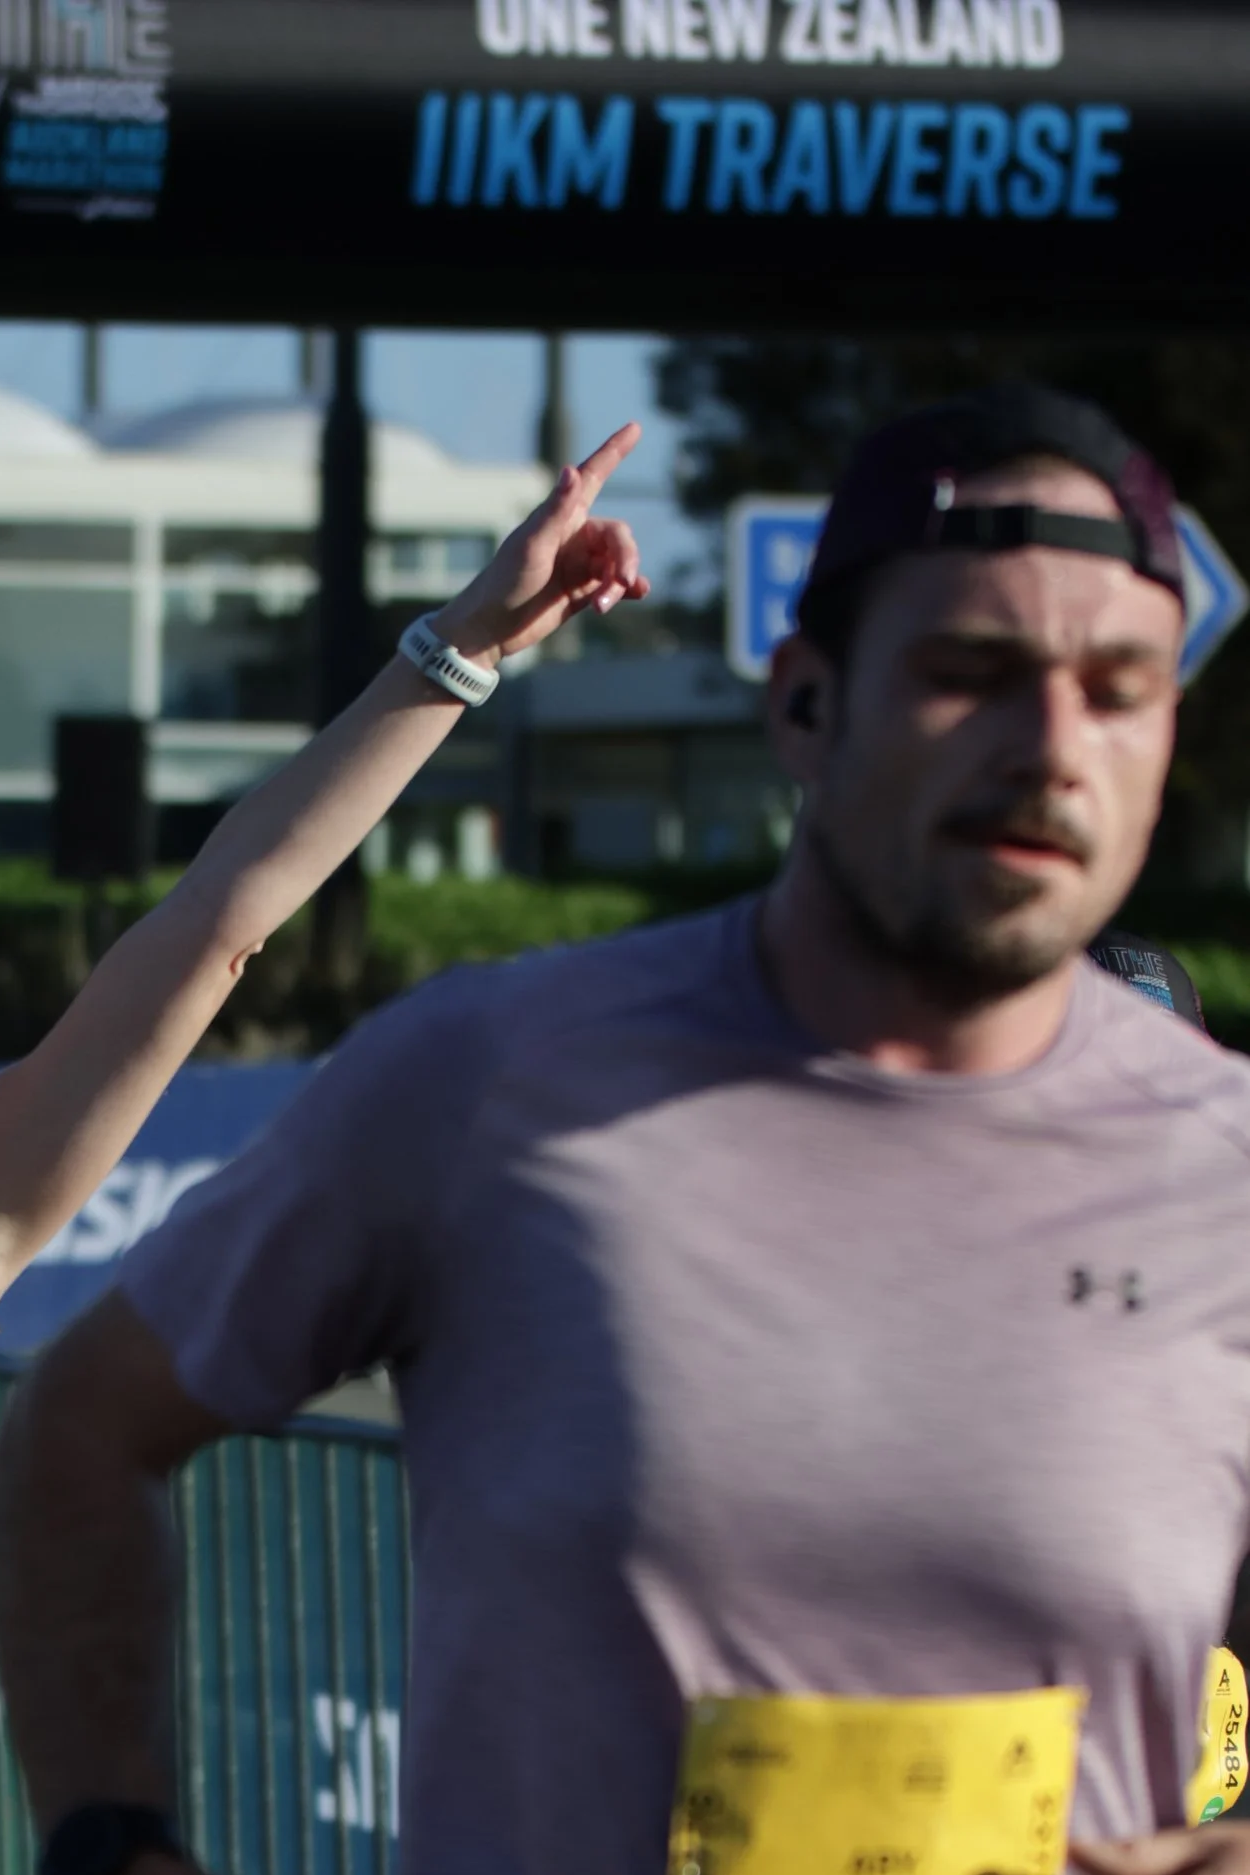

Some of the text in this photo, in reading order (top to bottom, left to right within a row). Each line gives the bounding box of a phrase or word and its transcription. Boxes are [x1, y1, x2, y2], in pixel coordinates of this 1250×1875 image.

[477, 0, 1064, 69] ONE NEW ZEALAND
[656, 96, 1130, 219] TRAVERSE
[1224, 1703, 1242, 1790] 25484
